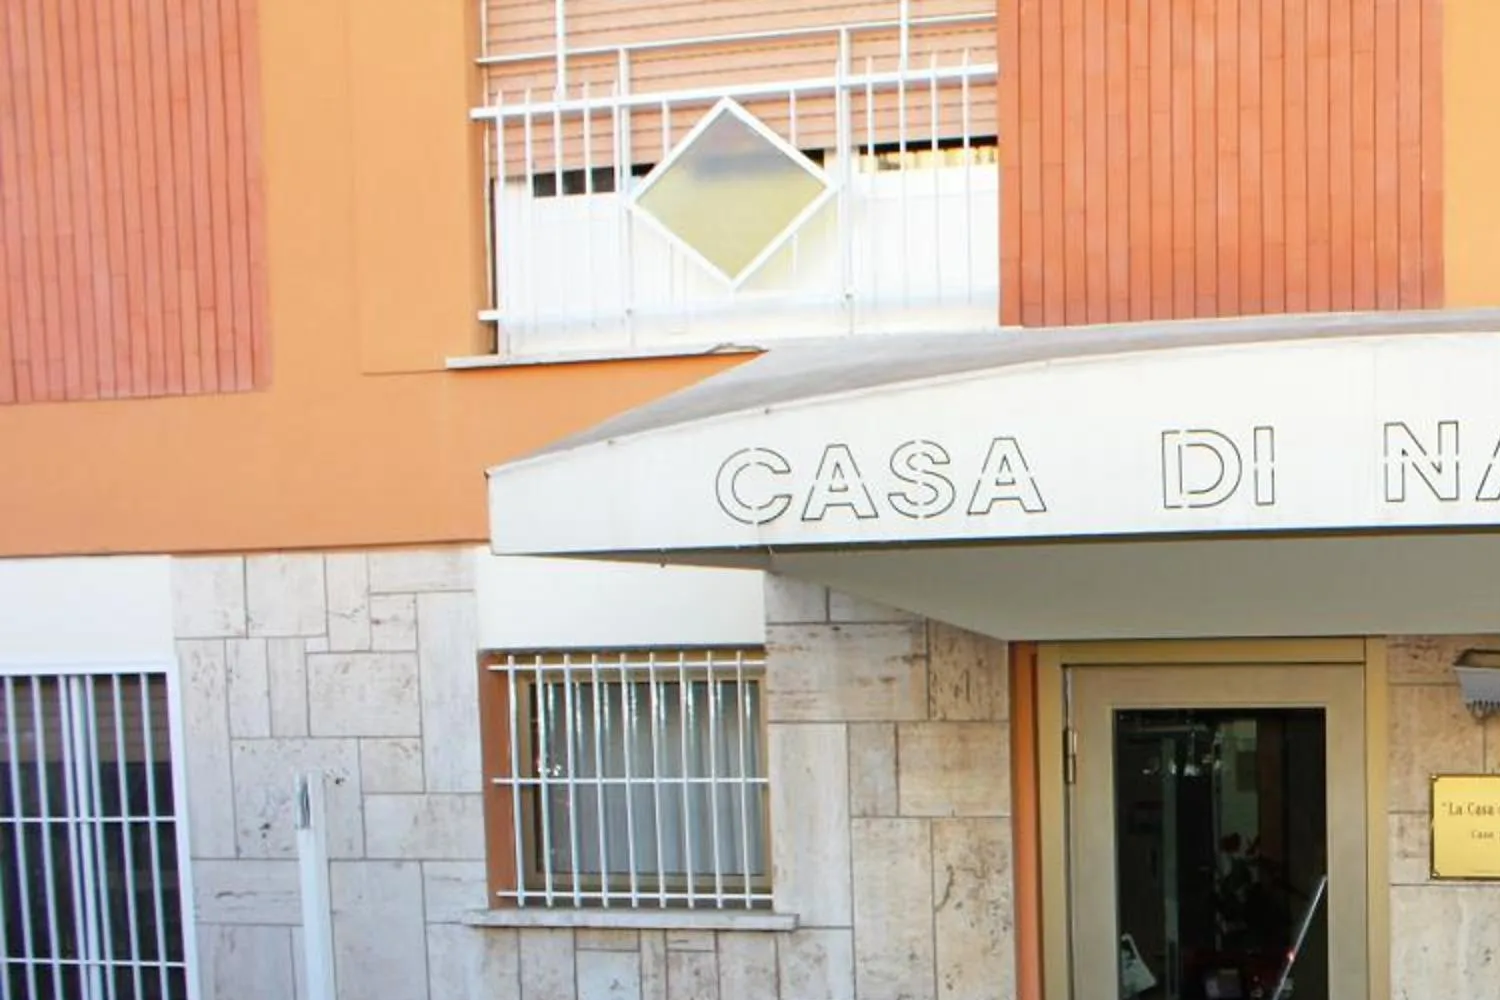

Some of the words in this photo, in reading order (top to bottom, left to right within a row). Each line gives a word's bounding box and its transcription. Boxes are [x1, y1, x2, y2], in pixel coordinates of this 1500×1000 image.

[715, 436, 1047, 525] CASA
[1161, 426, 1276, 509] DI
[1467, 801, 1495, 817] Casa
